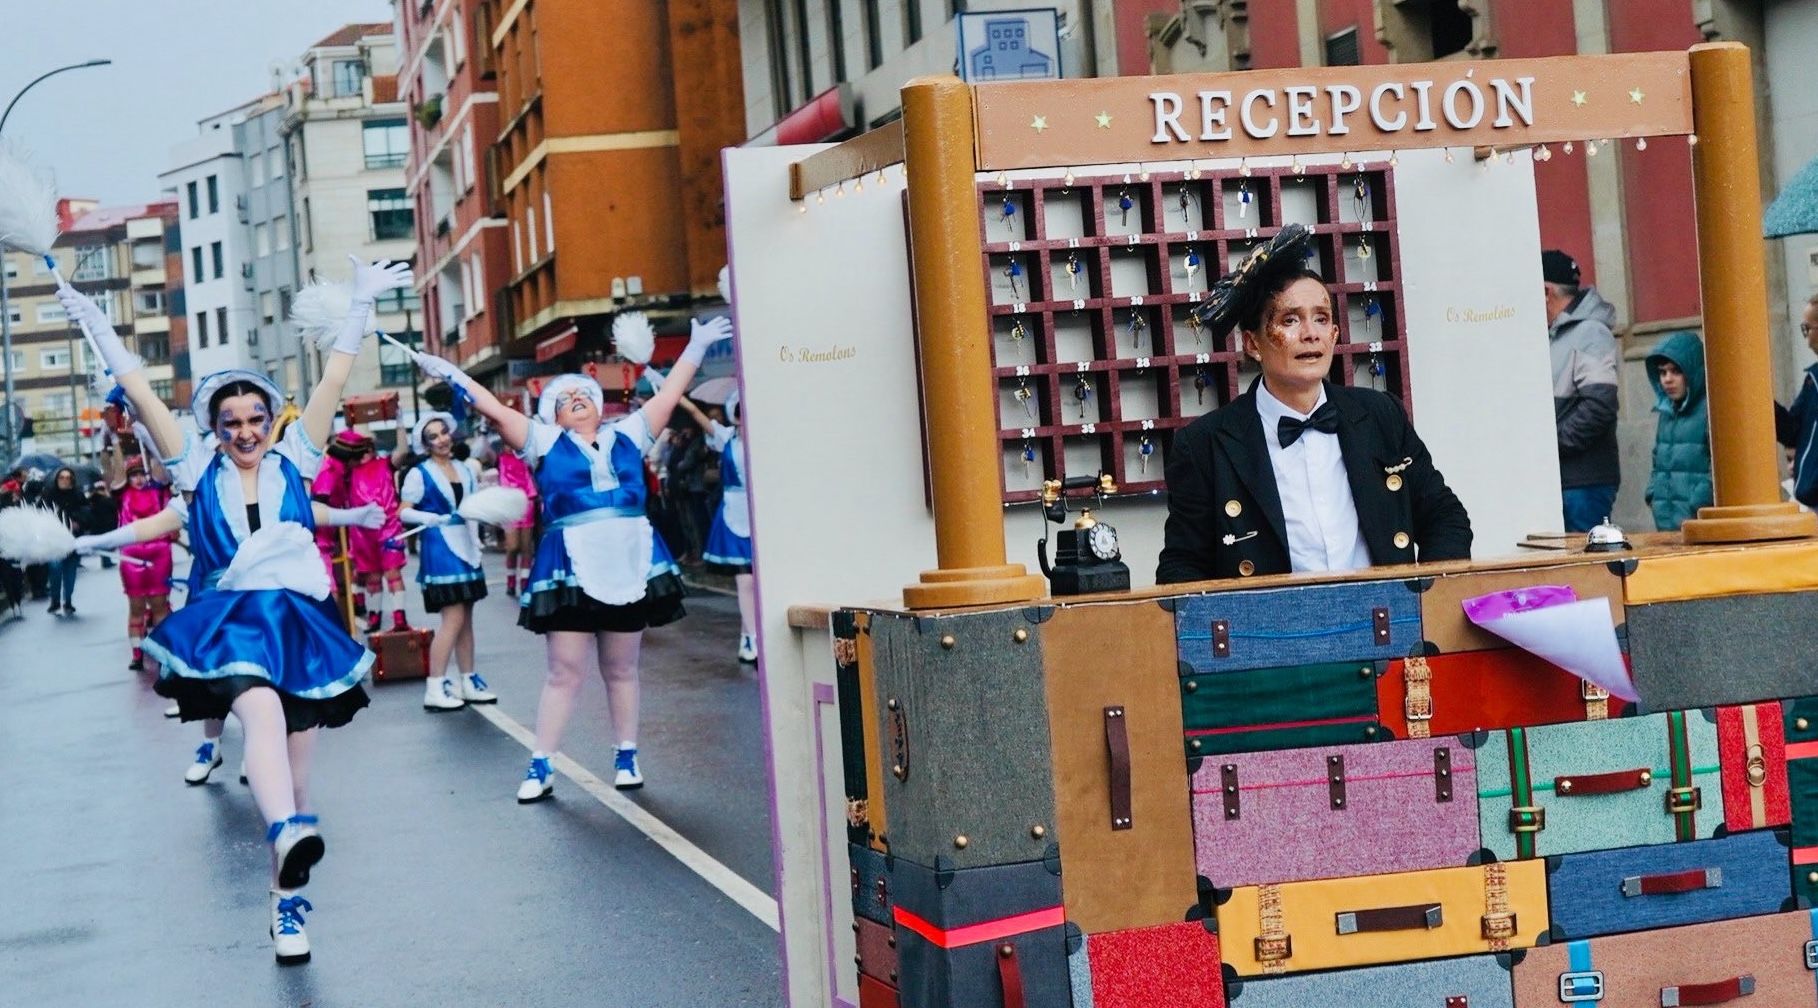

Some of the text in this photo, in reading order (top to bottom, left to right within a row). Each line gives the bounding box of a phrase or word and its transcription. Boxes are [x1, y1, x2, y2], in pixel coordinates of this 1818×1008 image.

[1149, 68, 1534, 142] RECEPCIÓN
[1304, 224, 1316, 235] 15
[1360, 222, 1373, 232] 16
[1186, 231, 1199, 241] 13
[1245, 228, 1258, 238] 14
[1068, 238, 1080, 248] 11
[1127, 234, 1140, 244] 12
[1008, 242, 1021, 252] 10
[1363, 282, 1377, 292] 24
[1130, 296, 1144, 306] 20
[1188, 292, 1201, 302] 21
[1073, 299, 1086, 309] 19
[1368, 342, 1383, 352] 32
[1136, 357, 1150, 368] 28
[1195, 353, 1210, 364] 29
[1077, 361, 1091, 371] 27
[1081, 424, 1095, 434] 35
[1141, 420, 1154, 430] 36
[1021, 428, 1036, 438] 34
